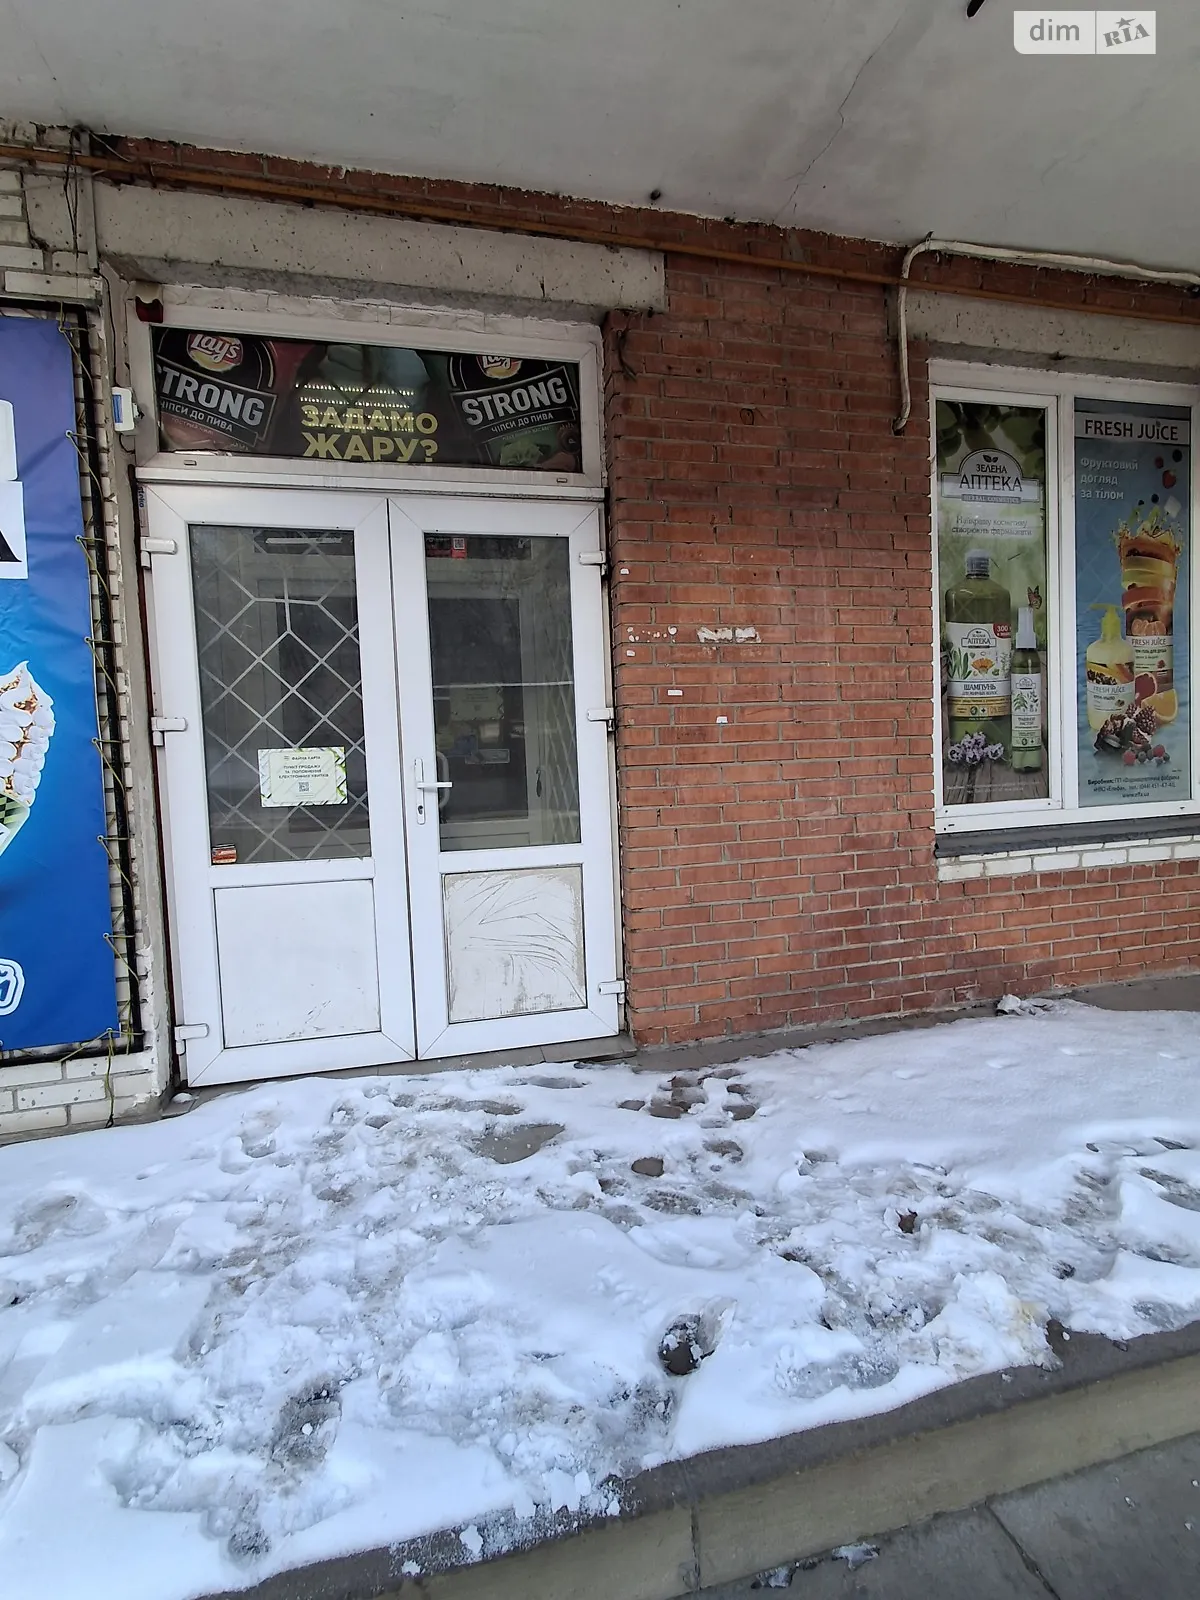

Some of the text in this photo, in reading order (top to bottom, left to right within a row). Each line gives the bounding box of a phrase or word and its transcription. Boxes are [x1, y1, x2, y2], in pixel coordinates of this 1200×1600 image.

[157, 363, 265, 426] TRONG
[462, 378, 568, 426] STRONG
[190, 410, 204, 420] ДО
[206, 415, 233, 432] ПИВА
[301, 404, 438, 434] ЗАДАМО
[492, 420, 516, 432] ЧІПСИ
[518, 417, 530, 427] ДО
[531, 412, 554, 422] ПИВА
[1085, 420, 1132, 437] FRESH
[302, 432, 438, 462] ЖАРУ?
[976, 464, 1007, 474] ЗЕЛЕНА
[1080, 458, 1138, 470] Фруктовий
[959, 474, 1022, 492] АПТЕКА
[1080, 474, 1118, 485] догляд
[1081, 488, 1124, 499] за тілом
